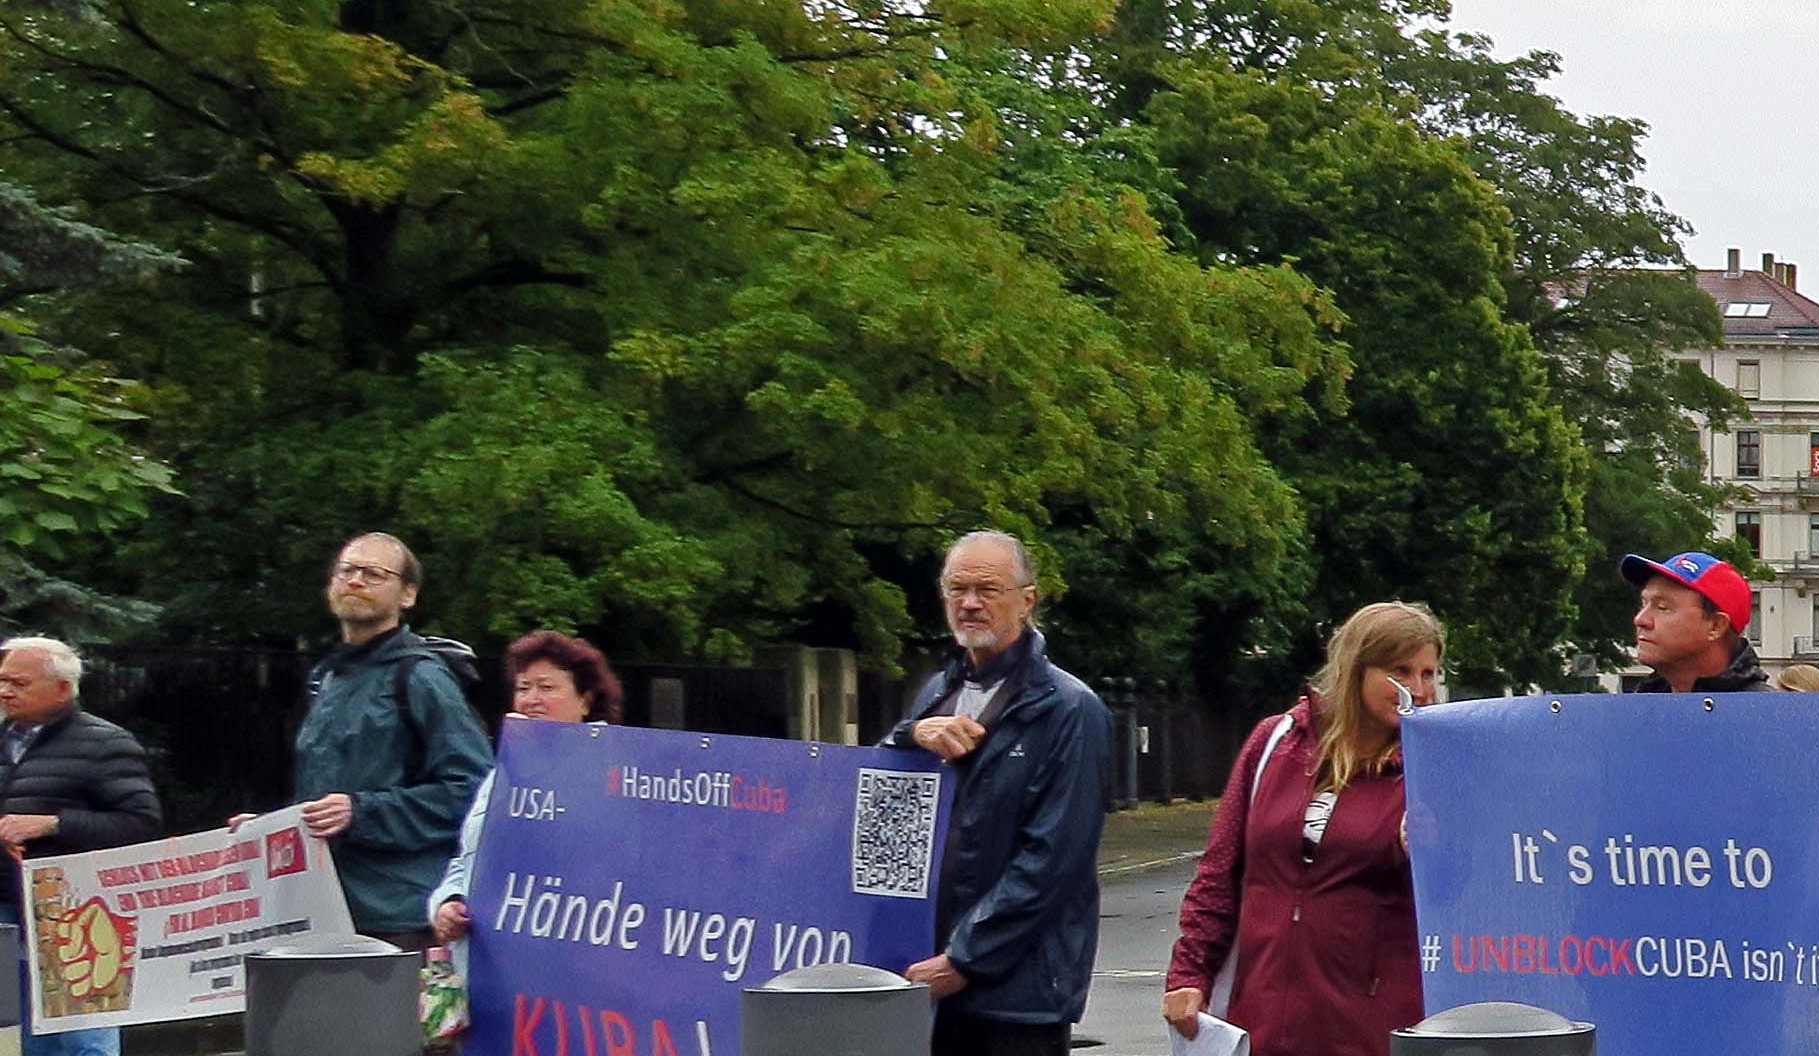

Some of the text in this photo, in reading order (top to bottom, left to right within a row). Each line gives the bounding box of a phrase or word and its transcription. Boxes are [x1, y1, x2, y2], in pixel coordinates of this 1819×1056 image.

[510, 786, 566, 821] USA-
[608, 765, 790, 813] #HandsOffCuba
[1605, 834, 1712, 887] time
[1723, 838, 1773, 889] to
[495, 872, 852, 982] Hände weg von
[1451, 935, 1733, 980] UNBLOCKCUBA
